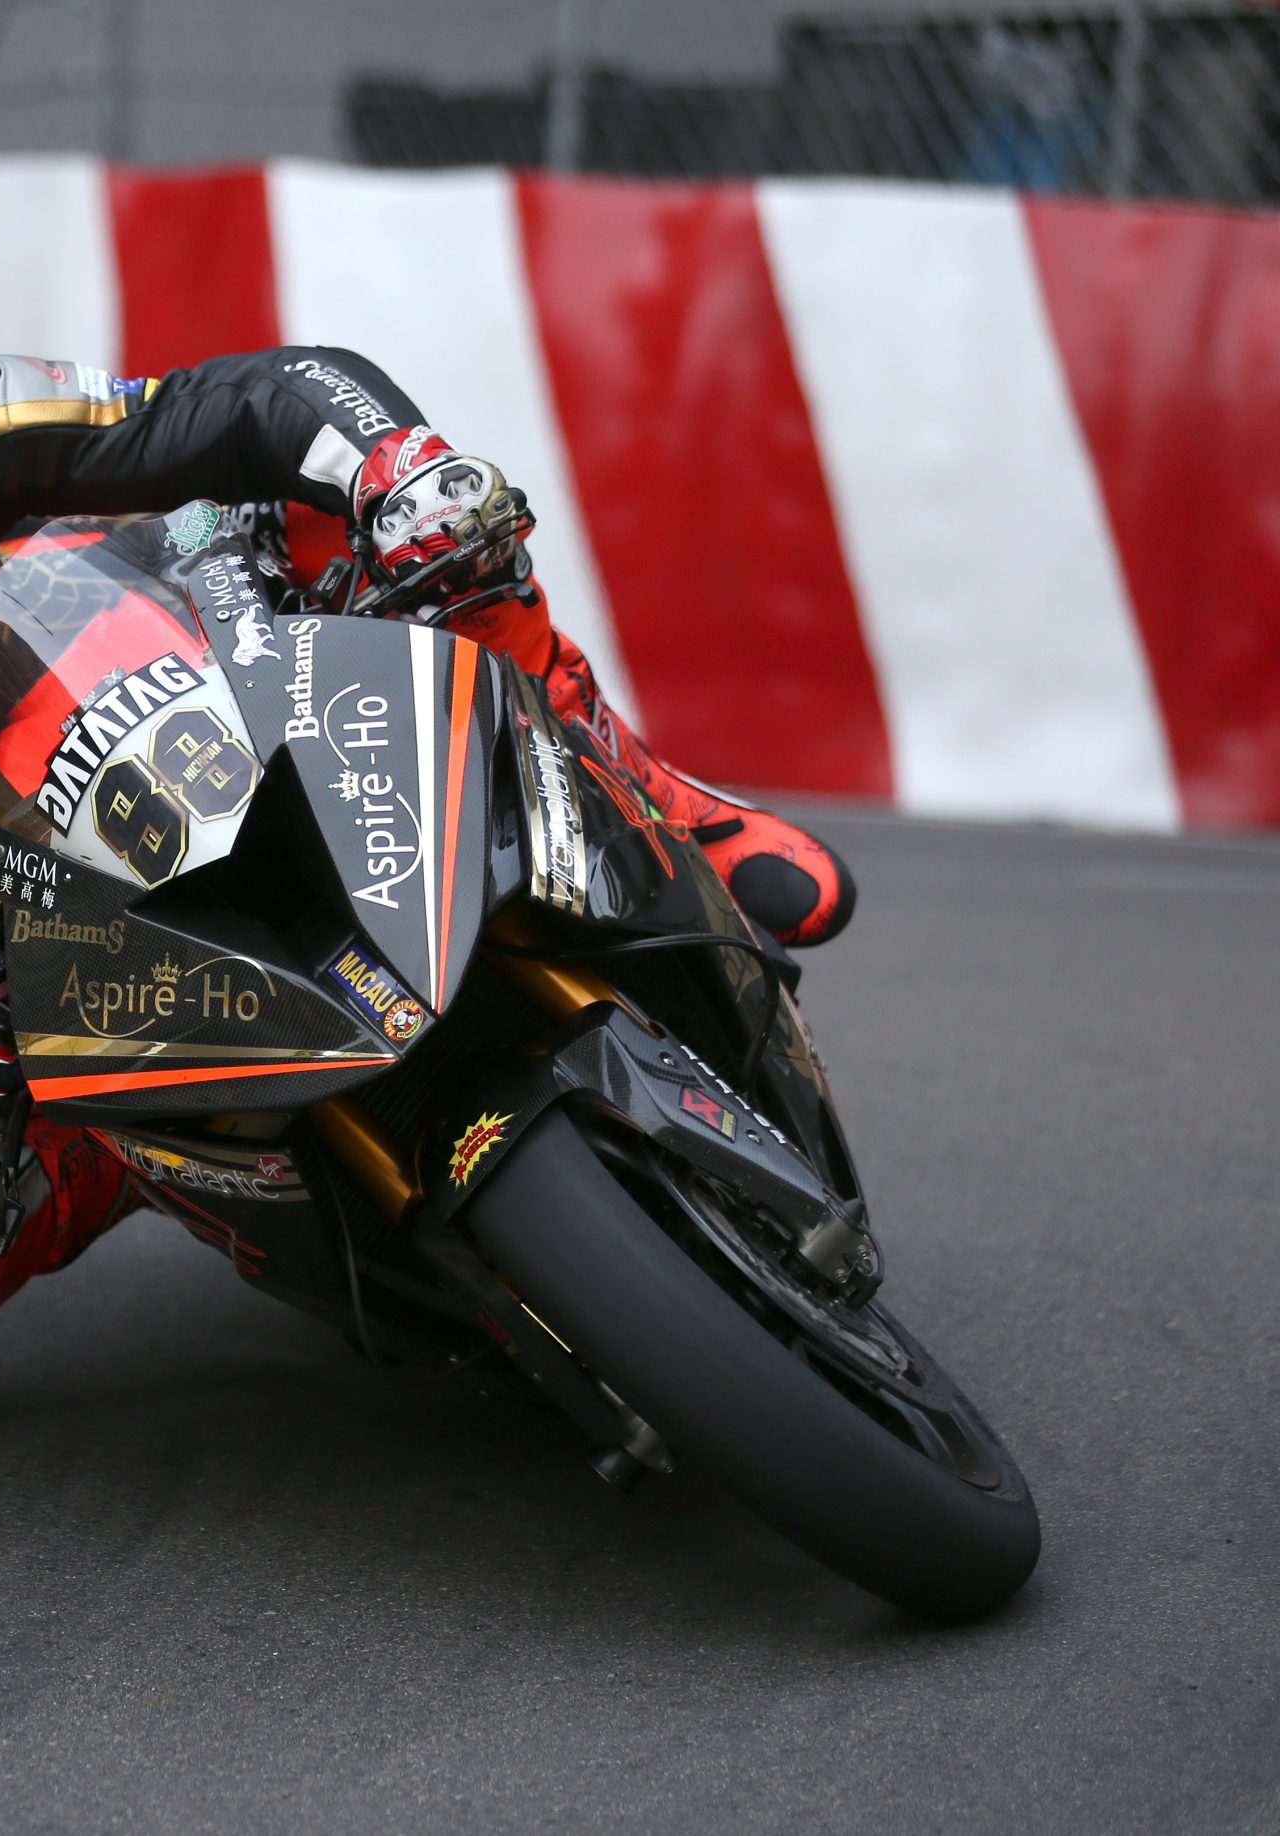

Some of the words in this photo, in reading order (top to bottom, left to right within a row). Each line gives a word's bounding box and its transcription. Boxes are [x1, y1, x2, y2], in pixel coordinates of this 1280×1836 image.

[455, 538, 485, 558] alpha
[200, 560, 237, 606] MGM
[37, 655, 198, 830] DATATAG
[4, 845, 57, 887] MGM
[0, 873, 55, 909] 美高梅
[335, 951, 398, 1013] MACAU
[458, 1124, 484, 1157] DAN
